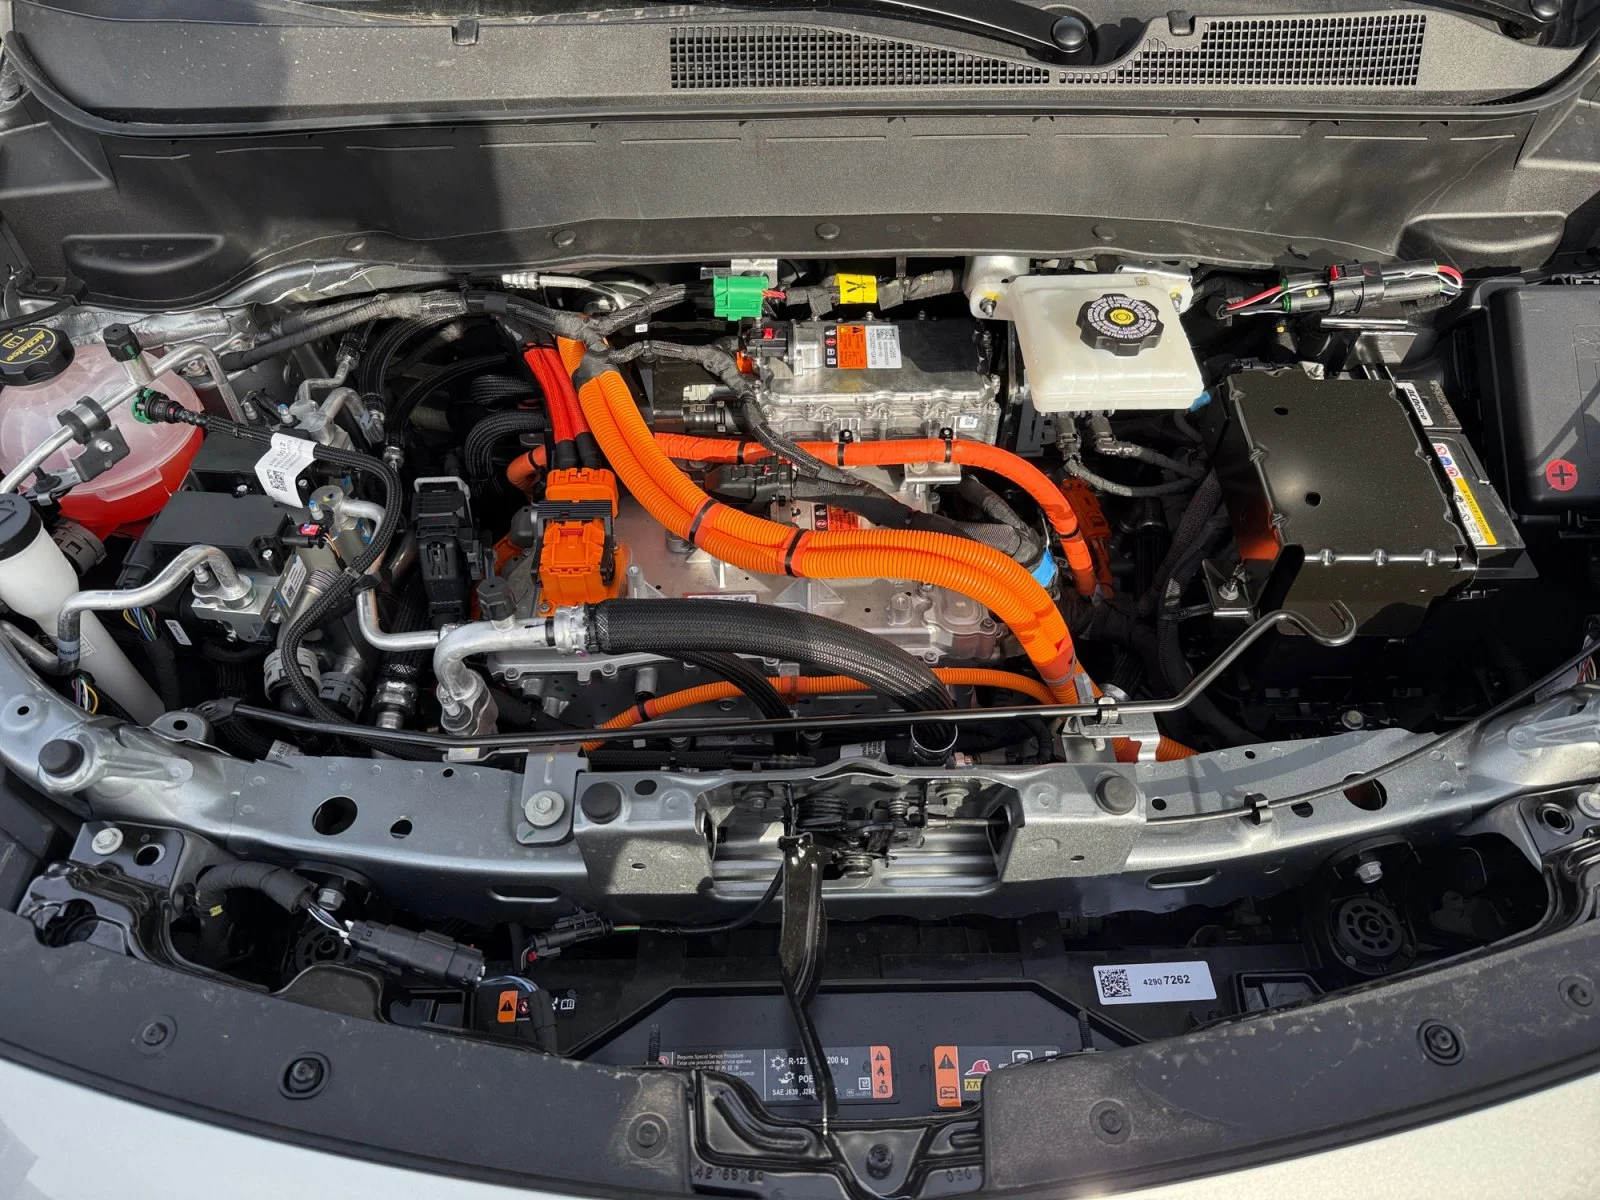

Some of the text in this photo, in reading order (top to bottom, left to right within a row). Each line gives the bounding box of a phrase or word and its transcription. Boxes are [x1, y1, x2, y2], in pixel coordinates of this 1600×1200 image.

[7, 330, 45, 361] ACDelco
[1406, 388, 1428, 420] ACDelco
[1143, 975, 1191, 986] 4290 7262
[826, 1056, 849, 1065] 200 kg
[798, 1075, 814, 1083] POE
[802, 1088, 816, 1096] J284
